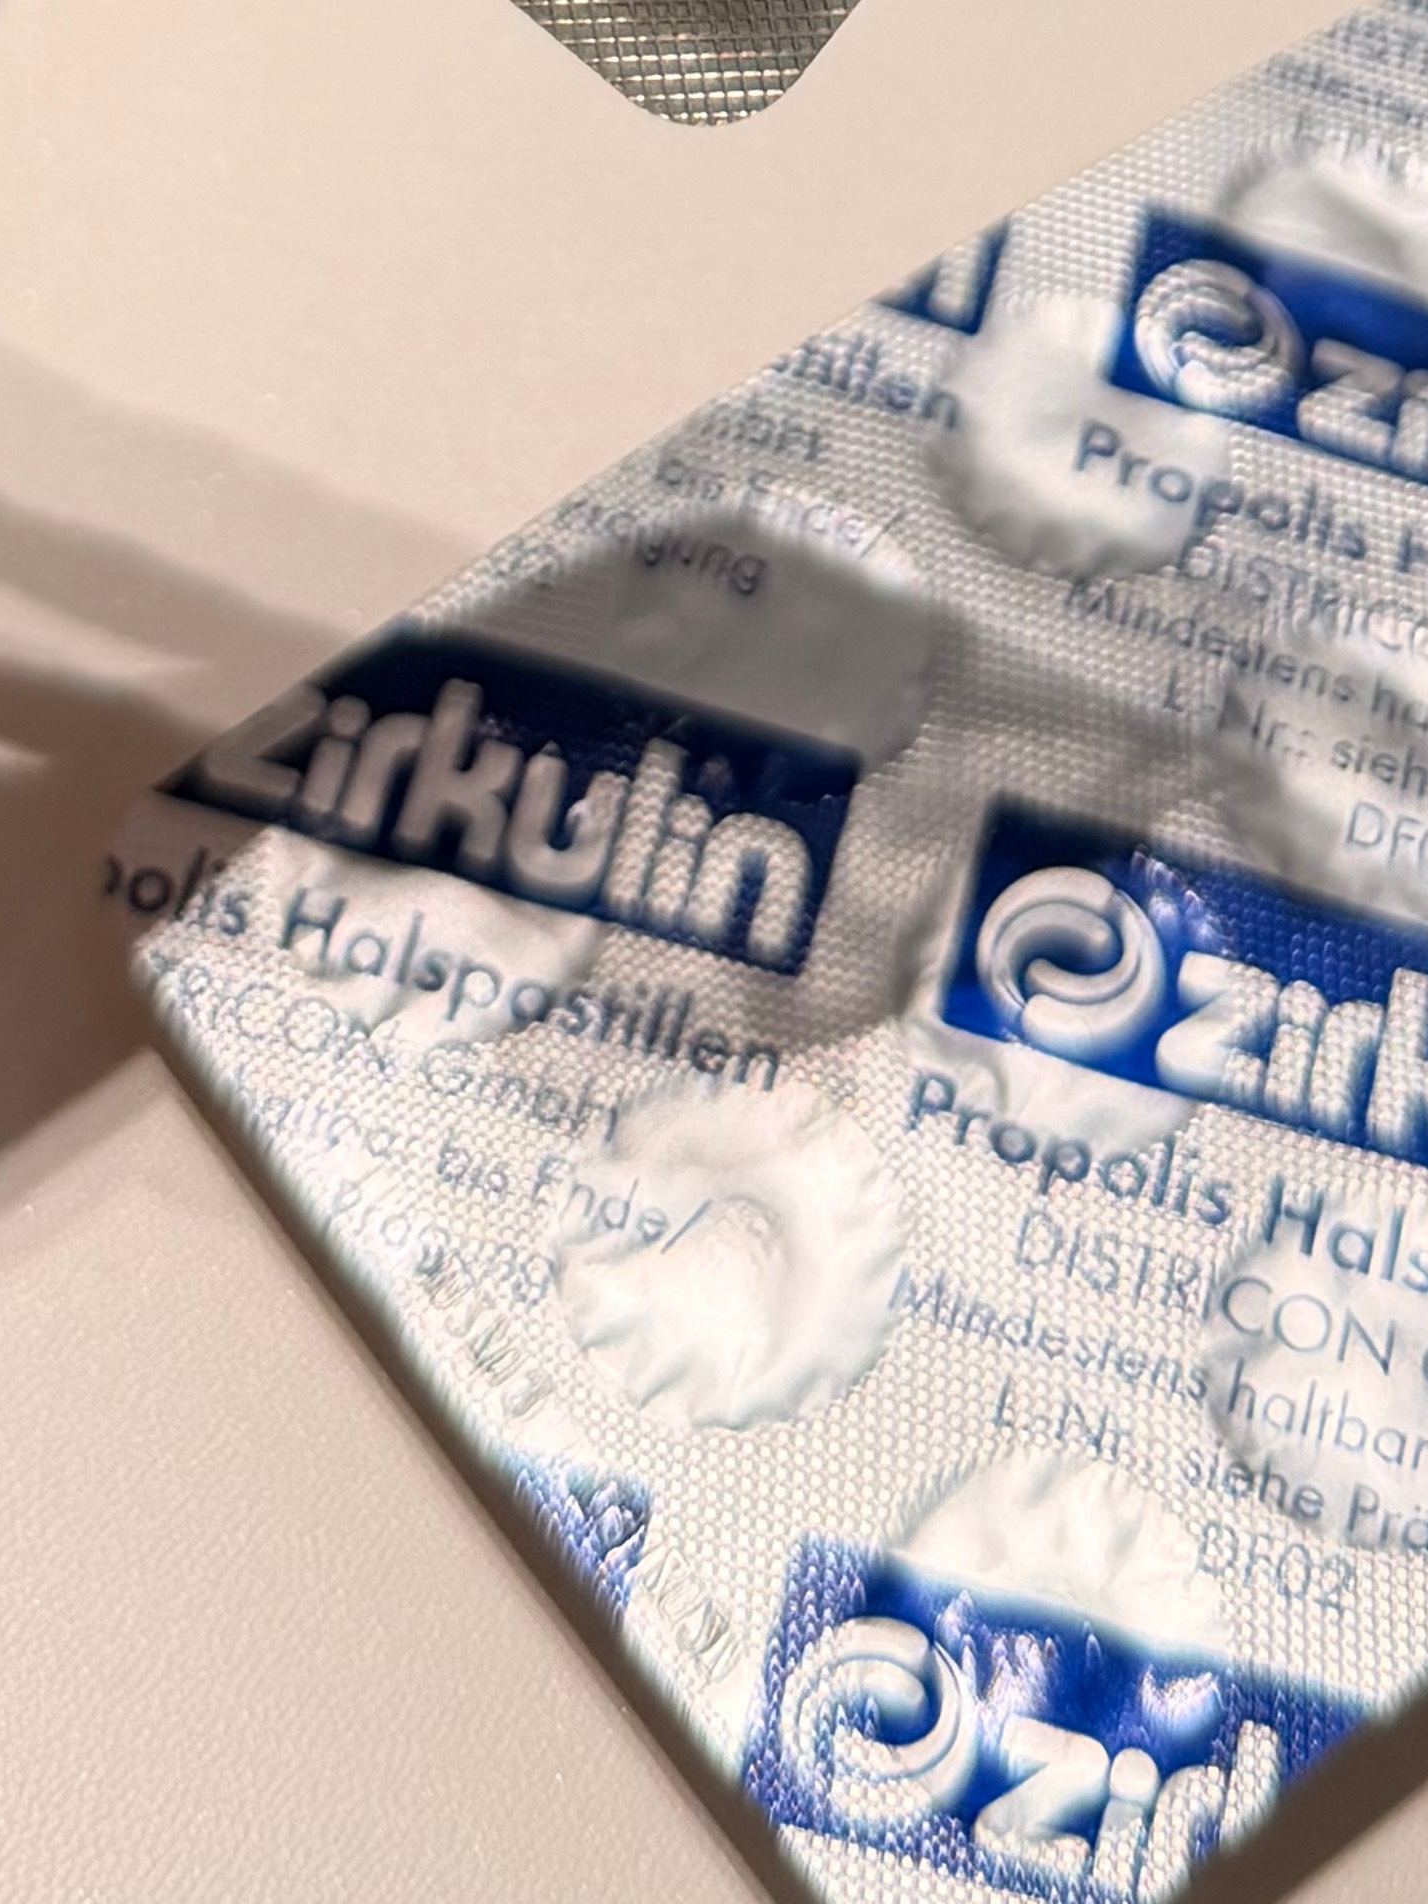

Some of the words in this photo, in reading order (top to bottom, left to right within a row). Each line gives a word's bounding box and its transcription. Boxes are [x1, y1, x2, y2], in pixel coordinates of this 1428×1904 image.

[1072, 416, 1368, 562] Propolis
[278, 886, 782, 1094] Halspastillen
[904, 1068, 1234, 1228] Propolis
[886, 1264, 1210, 1402] Mindestens
[1014, 1204, 1398, 1378] DISTRICON
[1180, 1440, 1326, 1524] siehe
